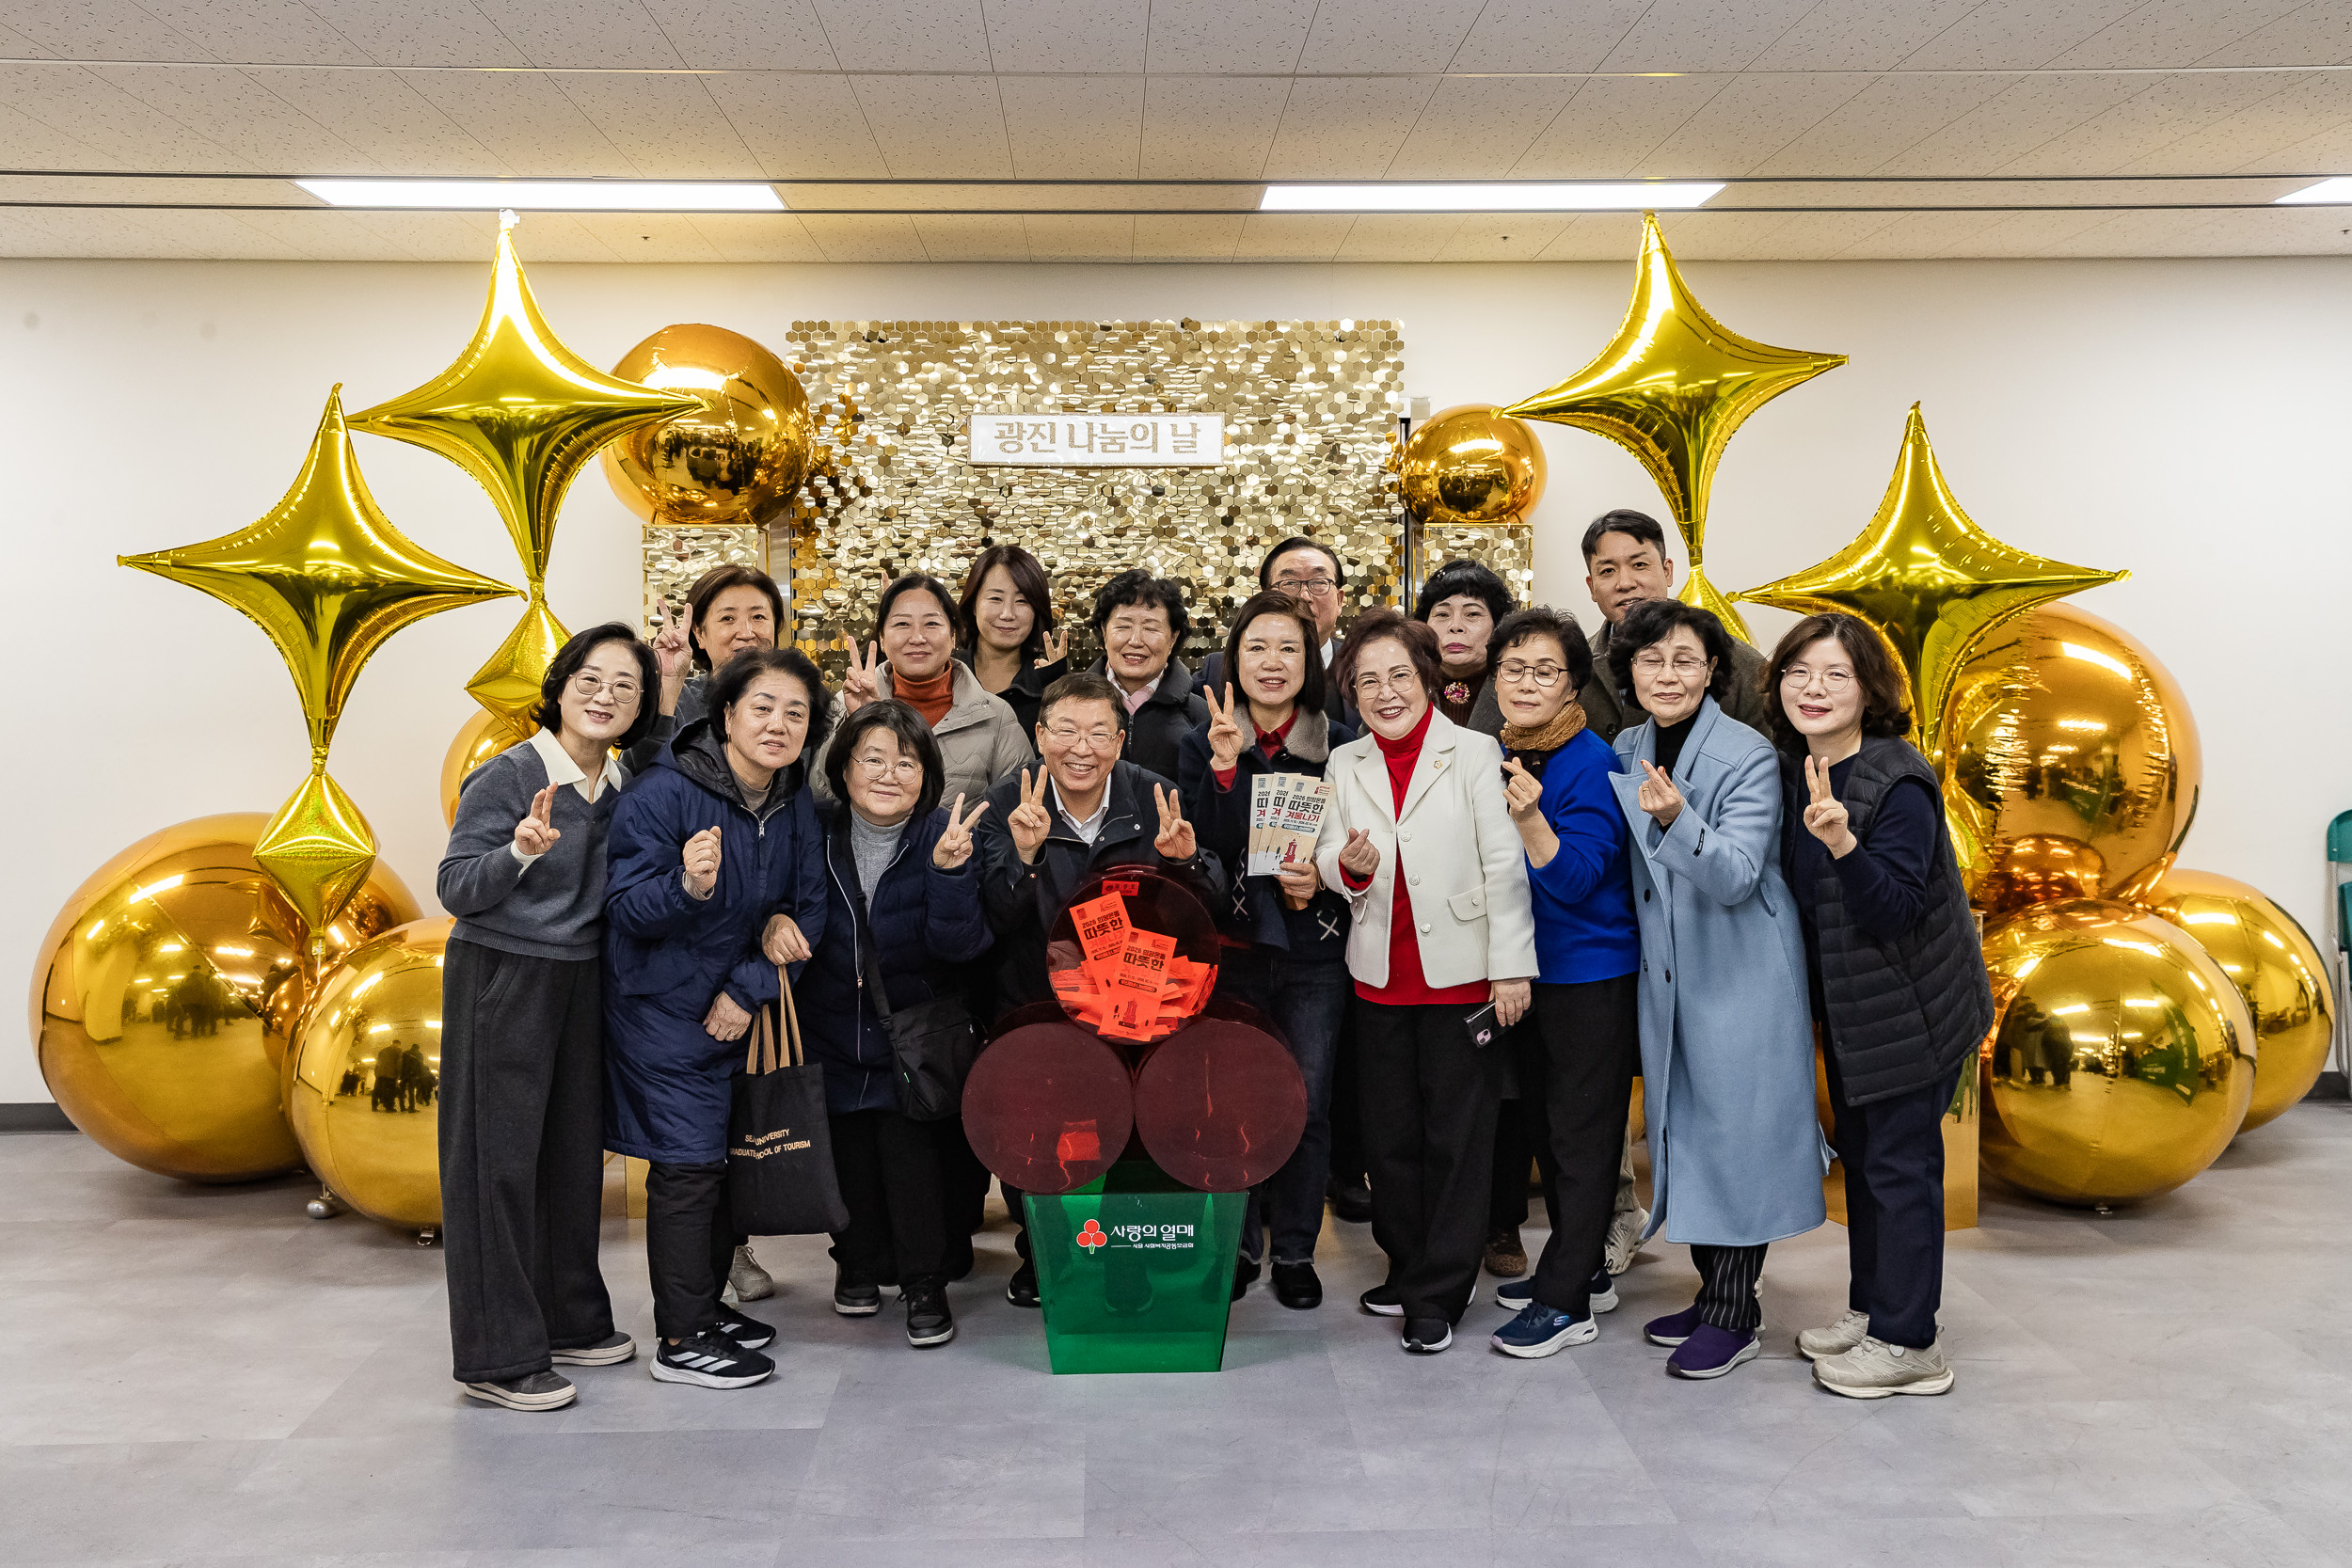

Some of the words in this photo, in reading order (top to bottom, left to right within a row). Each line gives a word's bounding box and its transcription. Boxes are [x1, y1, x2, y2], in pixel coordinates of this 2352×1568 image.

[994, 420, 1057, 454] 광진
[1067, 420, 1158, 453] 나눔의
[1169, 420, 1201, 453] 날
[1285, 810, 1320, 822] 겨울나기
[1288, 800, 1324, 815] 따뜻한
[1084, 917, 1123, 940] 따뜻한
[1123, 952, 1164, 972] 따뜻한
[755, 1129, 789, 1146] UNIVERSITY
[774, 1145, 782, 1153] OF
[783, 1140, 811, 1151] TOURISM
[1110, 1224, 1157, 1243] 사랑의
[1160, 1224, 1194, 1241] 열매
